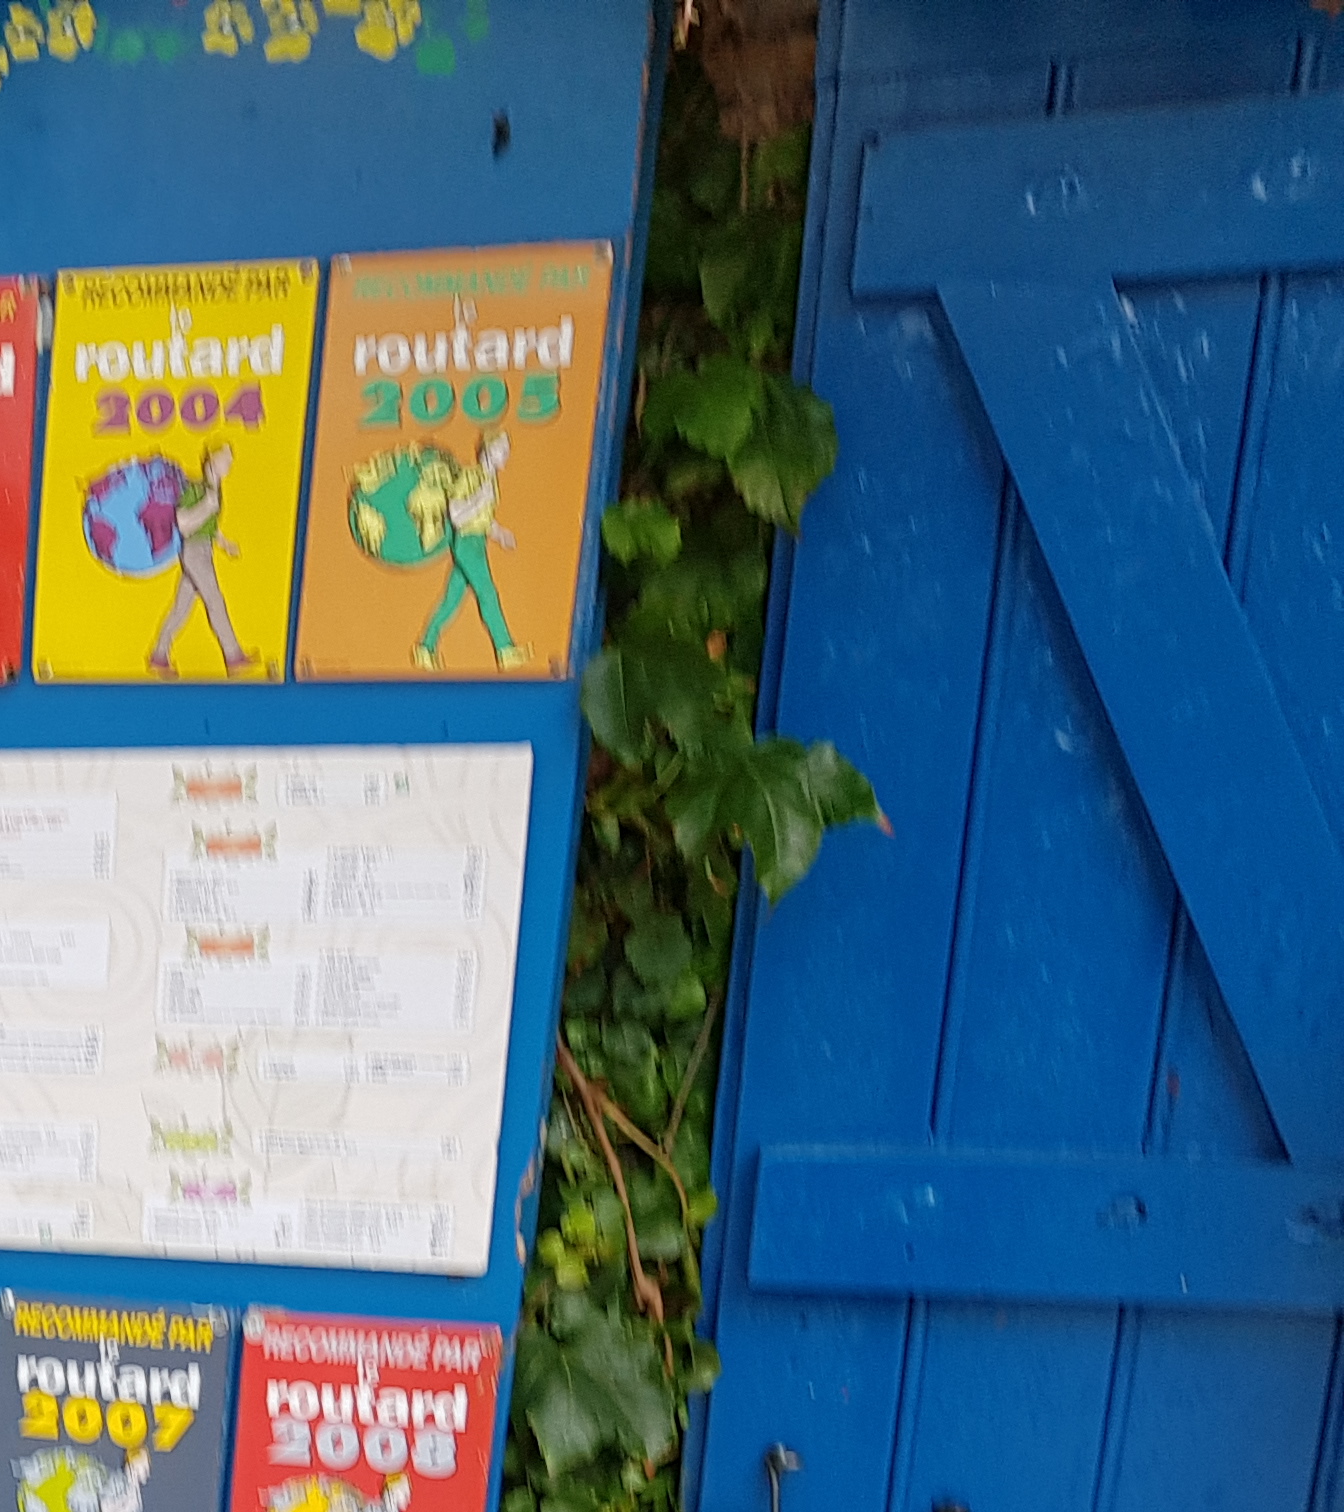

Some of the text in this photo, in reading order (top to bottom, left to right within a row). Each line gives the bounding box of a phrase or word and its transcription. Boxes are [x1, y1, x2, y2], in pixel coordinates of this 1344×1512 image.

[75, 323, 285, 383] routard
[354, 313, 573, 376] routard
[92, 380, 266, 438] 2004
[358, 369, 561, 430] 2005
[168, 1313, 213, 1355] PAR
[432, 1334, 481, 1375] PAR
[17, 1354, 201, 1411] routard
[267, 1378, 468, 1433] routard
[19, 1387, 195, 1452] 2007
[266, 1413, 457, 1480] 2008
